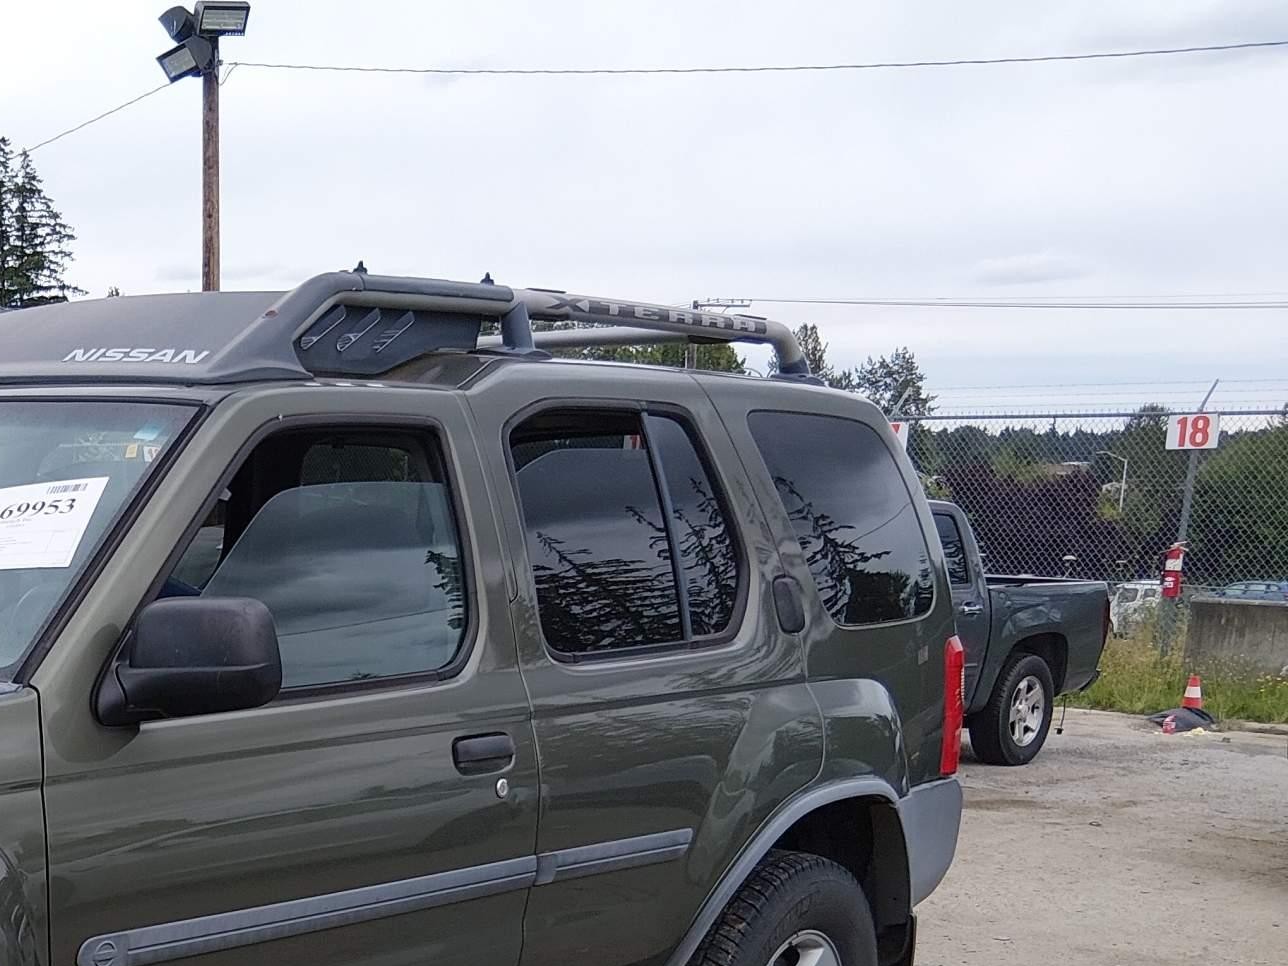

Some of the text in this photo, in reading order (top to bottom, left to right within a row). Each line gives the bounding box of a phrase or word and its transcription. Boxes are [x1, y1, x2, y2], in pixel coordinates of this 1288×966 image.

[546, 294, 756, 332] XTERRA
[62, 348, 211, 364] NISSAN
[1176, 415, 1211, 448] 18
